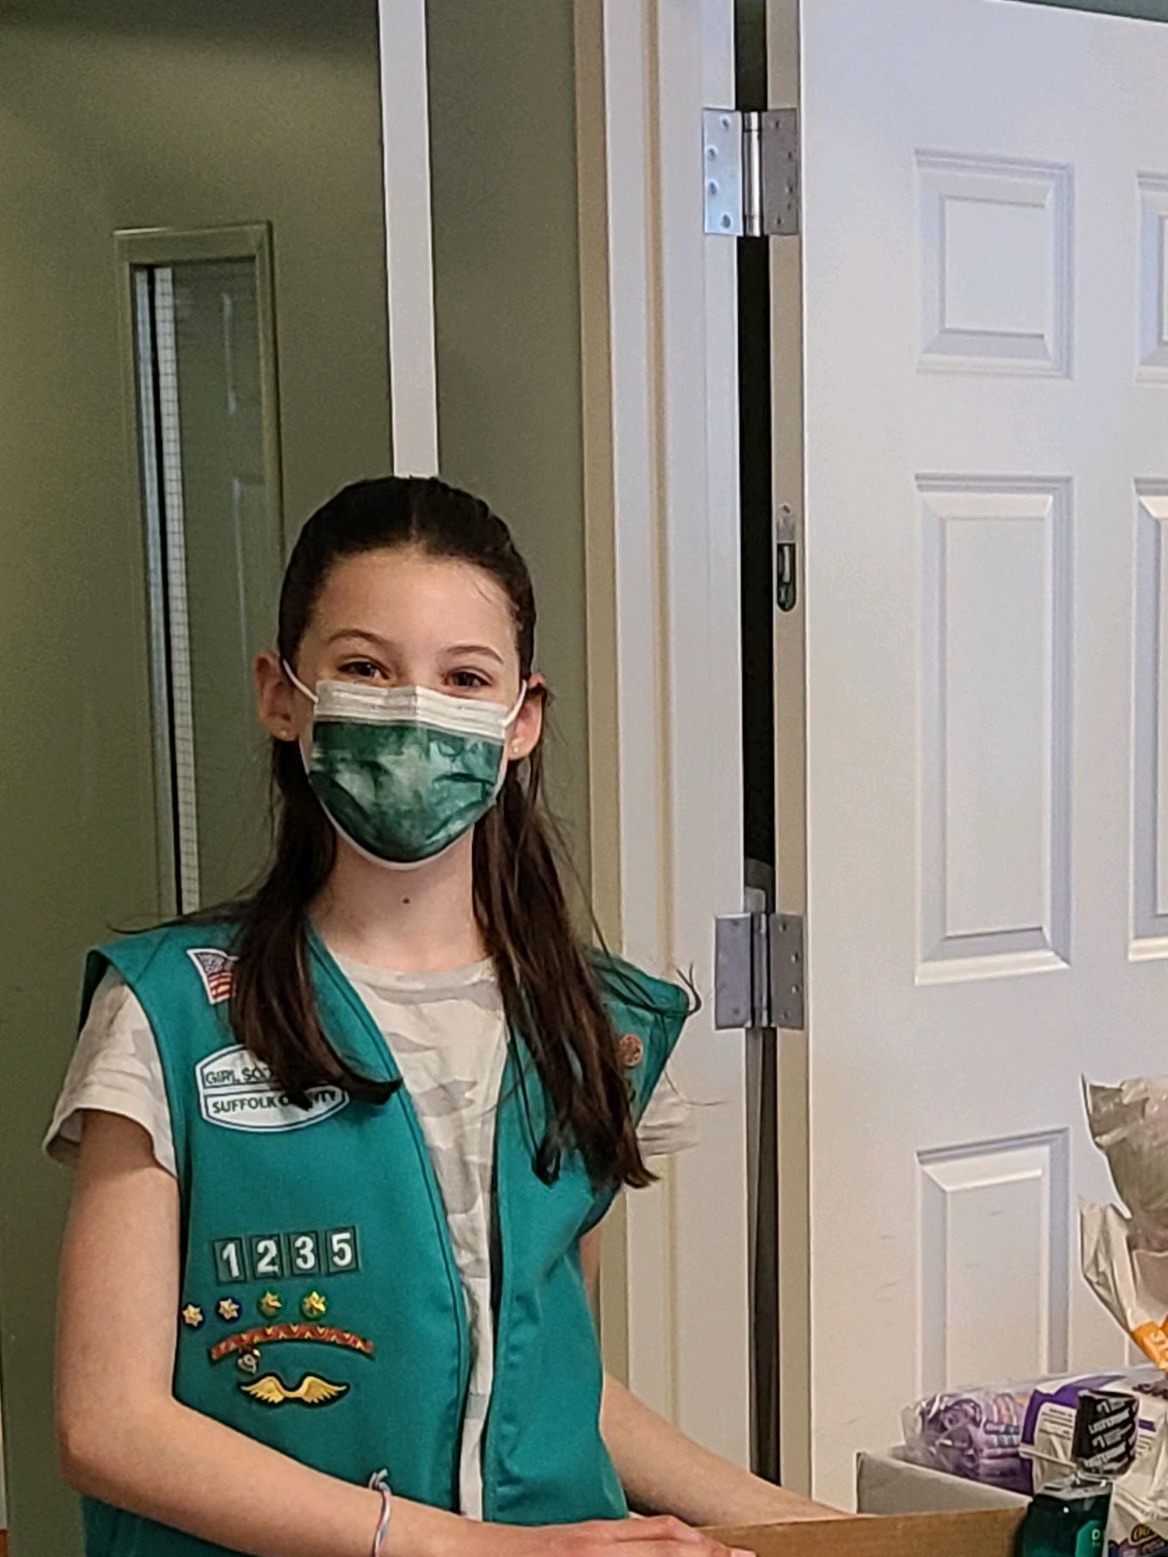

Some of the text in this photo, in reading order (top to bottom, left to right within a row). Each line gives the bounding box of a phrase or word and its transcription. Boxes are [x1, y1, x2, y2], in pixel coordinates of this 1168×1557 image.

[205, 1068, 240, 1086] GIRL
[212, 1096, 277, 1115] SUFFOLK
[221, 1230, 353, 1279] 1235
